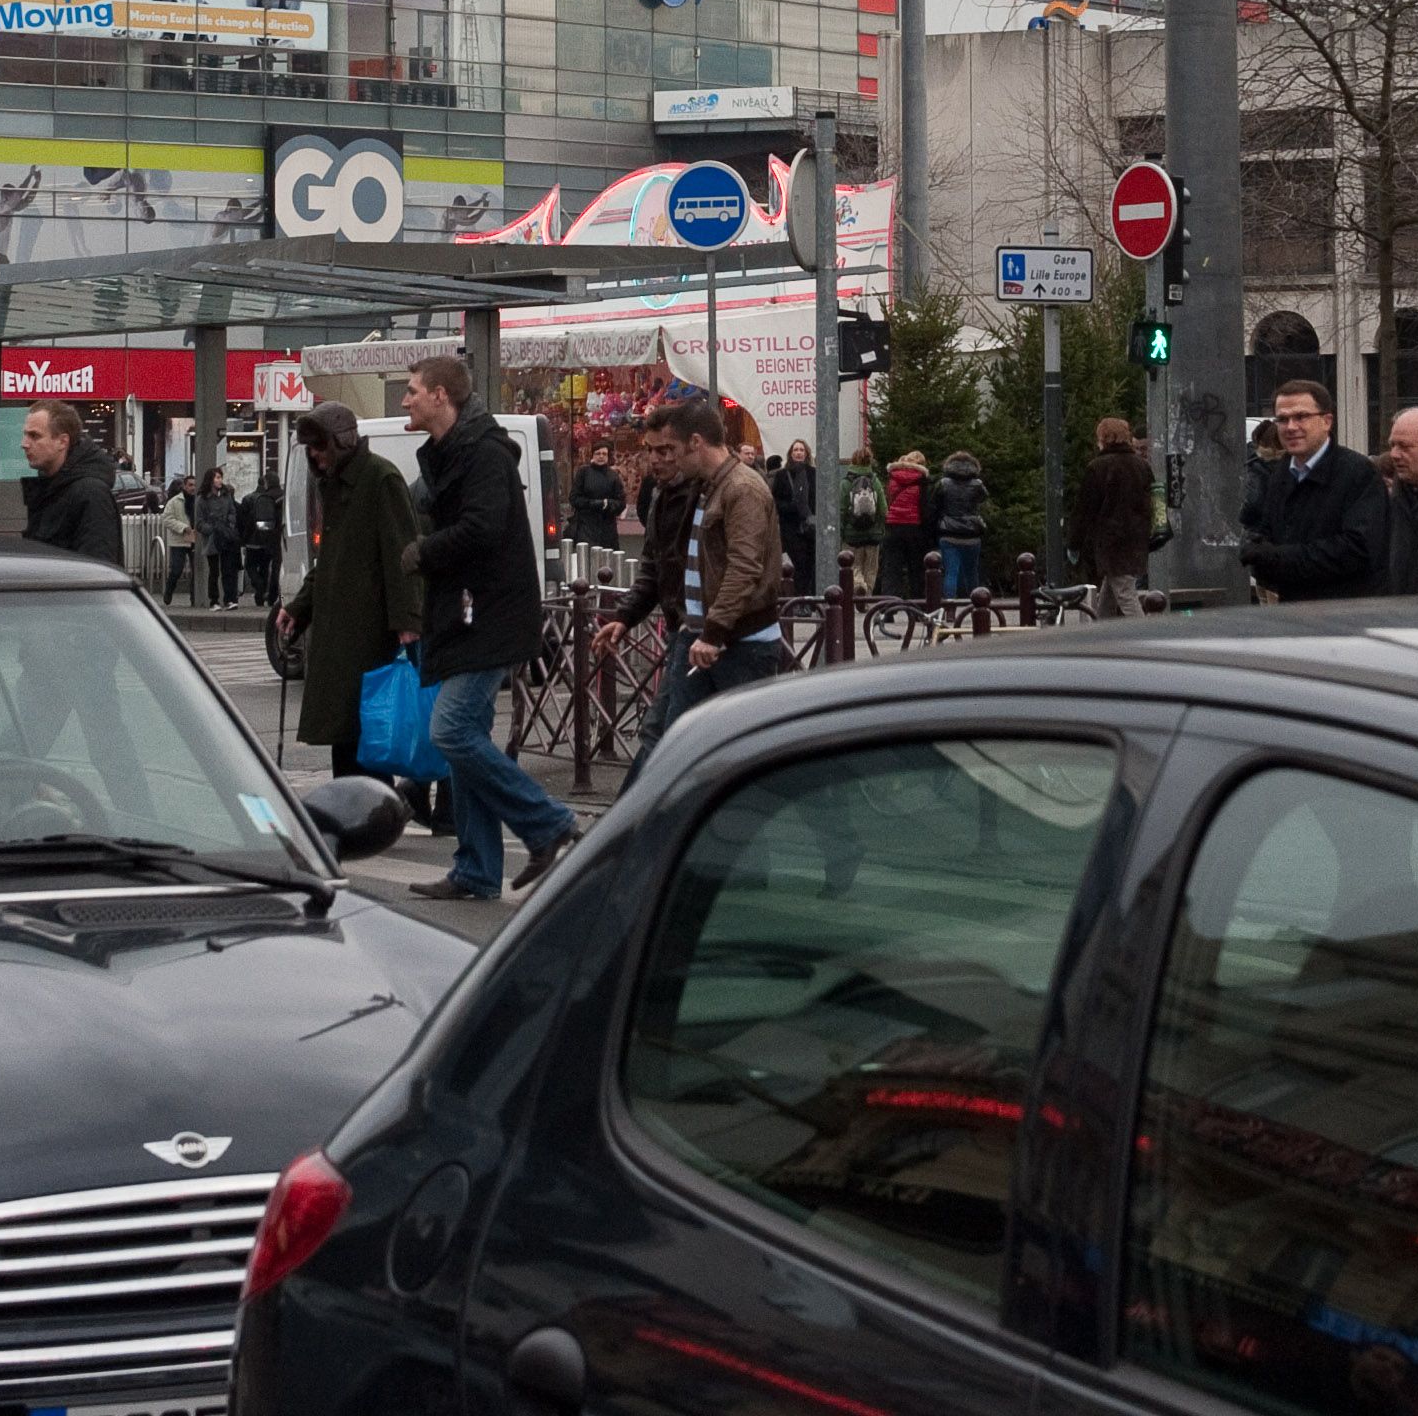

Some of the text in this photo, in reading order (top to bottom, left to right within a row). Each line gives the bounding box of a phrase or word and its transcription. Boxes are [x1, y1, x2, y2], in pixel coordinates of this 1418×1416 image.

[129, 10, 167, 25] Moving
[215, 15, 250, 31] change
[268, 18, 309, 32] direction
[732, 97, 768, 108] NIVEAU
[772, 95, 779, 107] 2
[274, 142, 404, 243] GO
[1054, 254, 1076, 265] Gare
[1031, 269, 1086, 283] Lille Europe
[1051, 287, 1070, 296] 400
[520, 341, 566, 361] BEIGNETS
[761, 379, 817, 395] GAUFRES
[767, 401, 817, 416] CREPES
